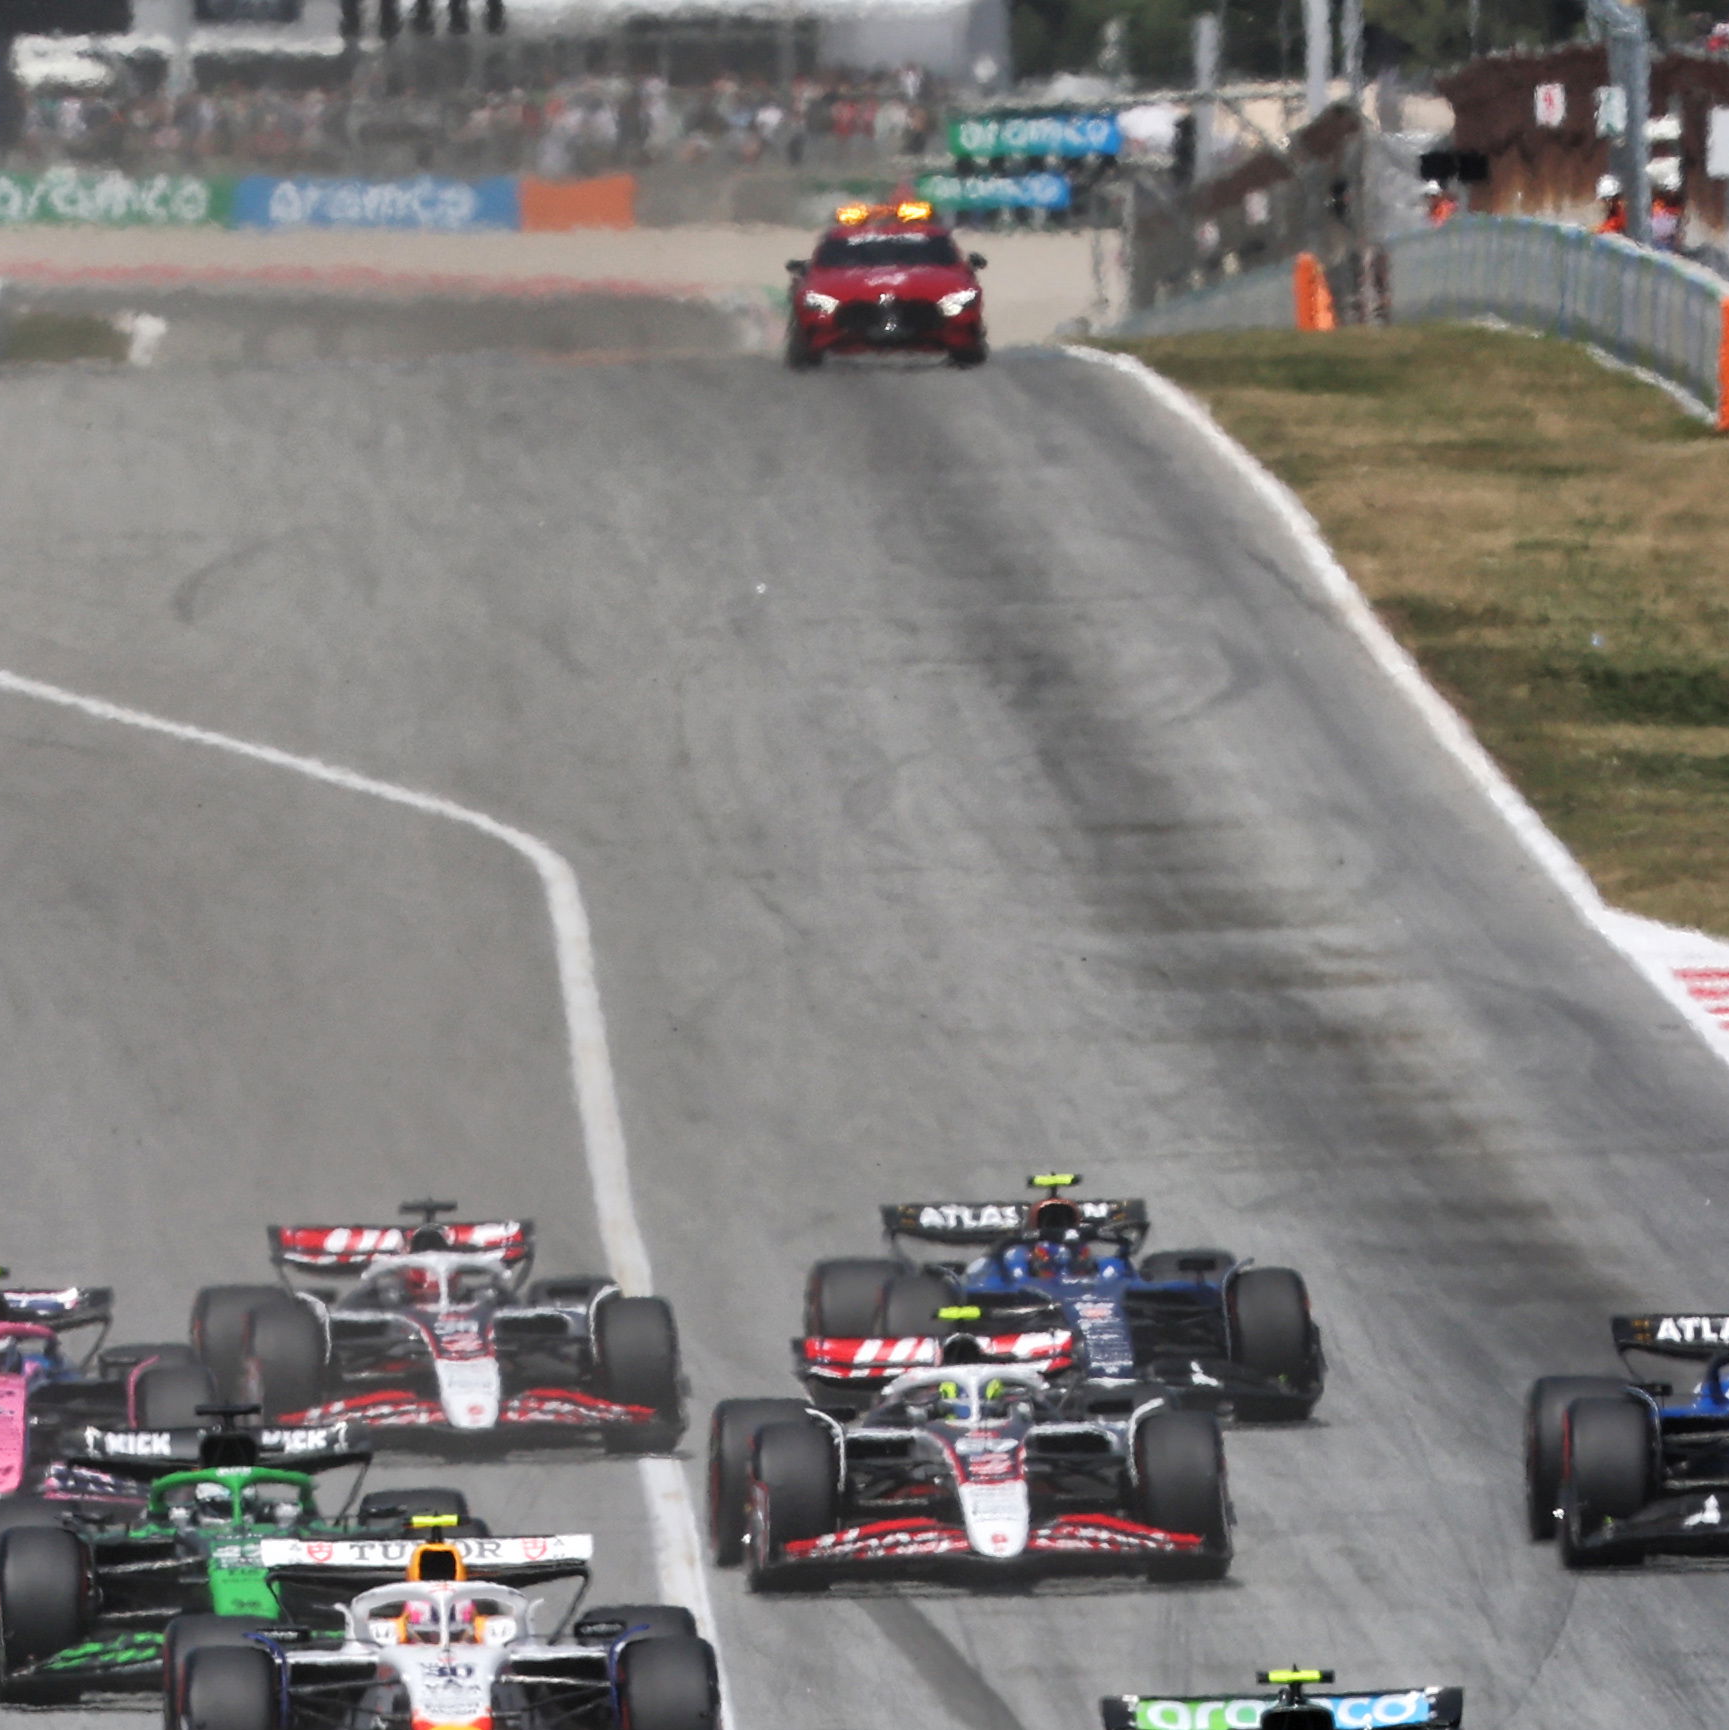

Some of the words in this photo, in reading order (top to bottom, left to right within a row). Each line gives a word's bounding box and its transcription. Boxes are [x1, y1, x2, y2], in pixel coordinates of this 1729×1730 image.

[269, 175, 477, 224] aramco
[919, 1202, 1109, 1229] ATLASN
[104, 1431, 171, 1455] KICK
[349, 1539, 502, 1561] TUR
